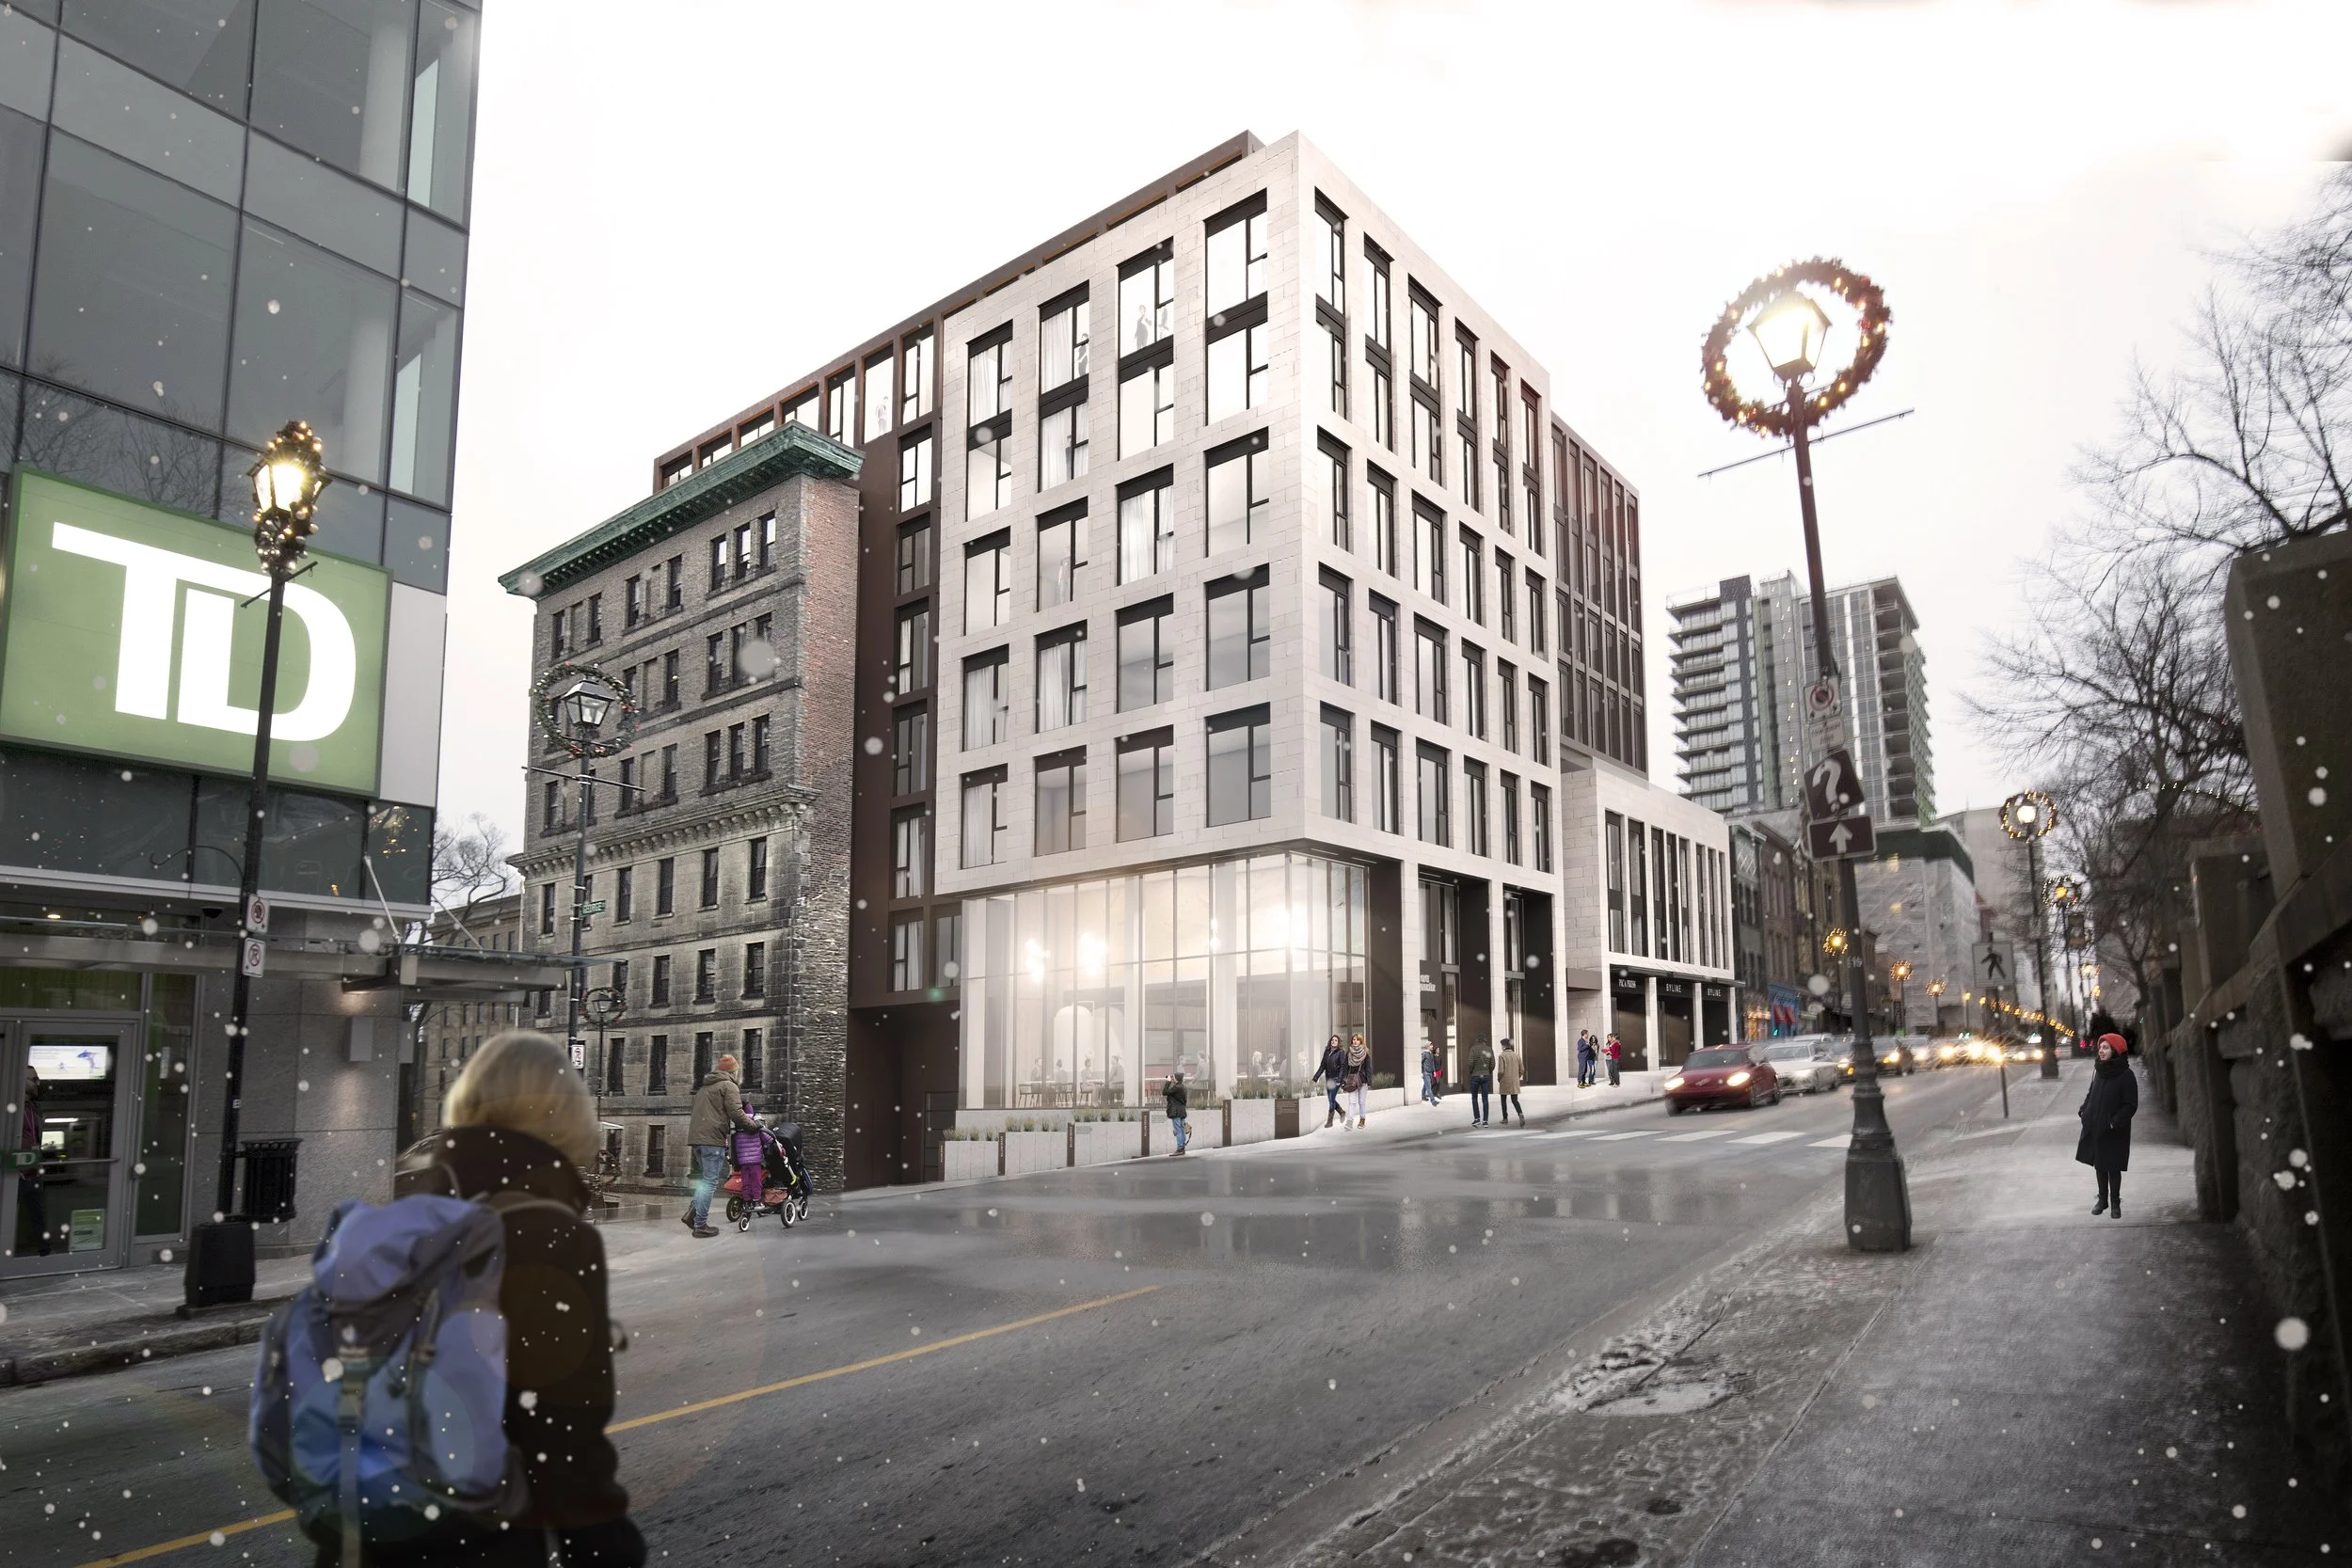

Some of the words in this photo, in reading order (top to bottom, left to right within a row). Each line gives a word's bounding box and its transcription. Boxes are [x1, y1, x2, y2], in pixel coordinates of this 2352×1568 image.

[52, 521, 356, 741] TD
[1666, 983, 1681, 993] BYLINE
[1708, 988, 1721, 997] BYLINE
[11, 1151, 36, 1166] TD
